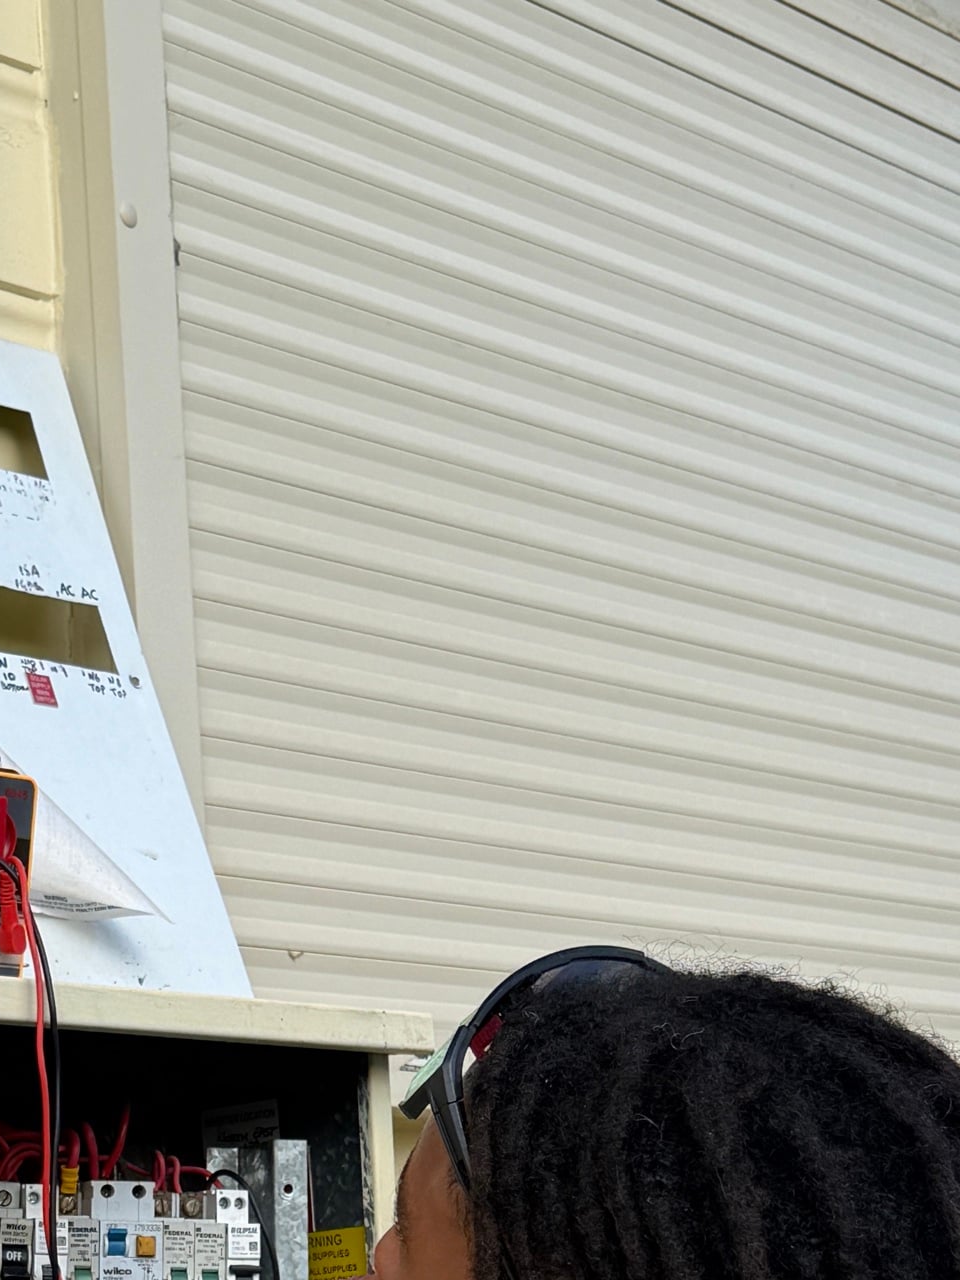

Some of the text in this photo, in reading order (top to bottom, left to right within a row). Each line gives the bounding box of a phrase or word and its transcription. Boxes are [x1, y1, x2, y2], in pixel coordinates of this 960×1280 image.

[60, 582, 76, 597] AC
[81, 586, 99, 601] AC
[309, 1234, 342, 1249] RNING
[6, 1251, 23, 1262] OFF
[103, 1266, 133, 1275] wilco
[323, 1264, 357, 1275] SUPPLIES
